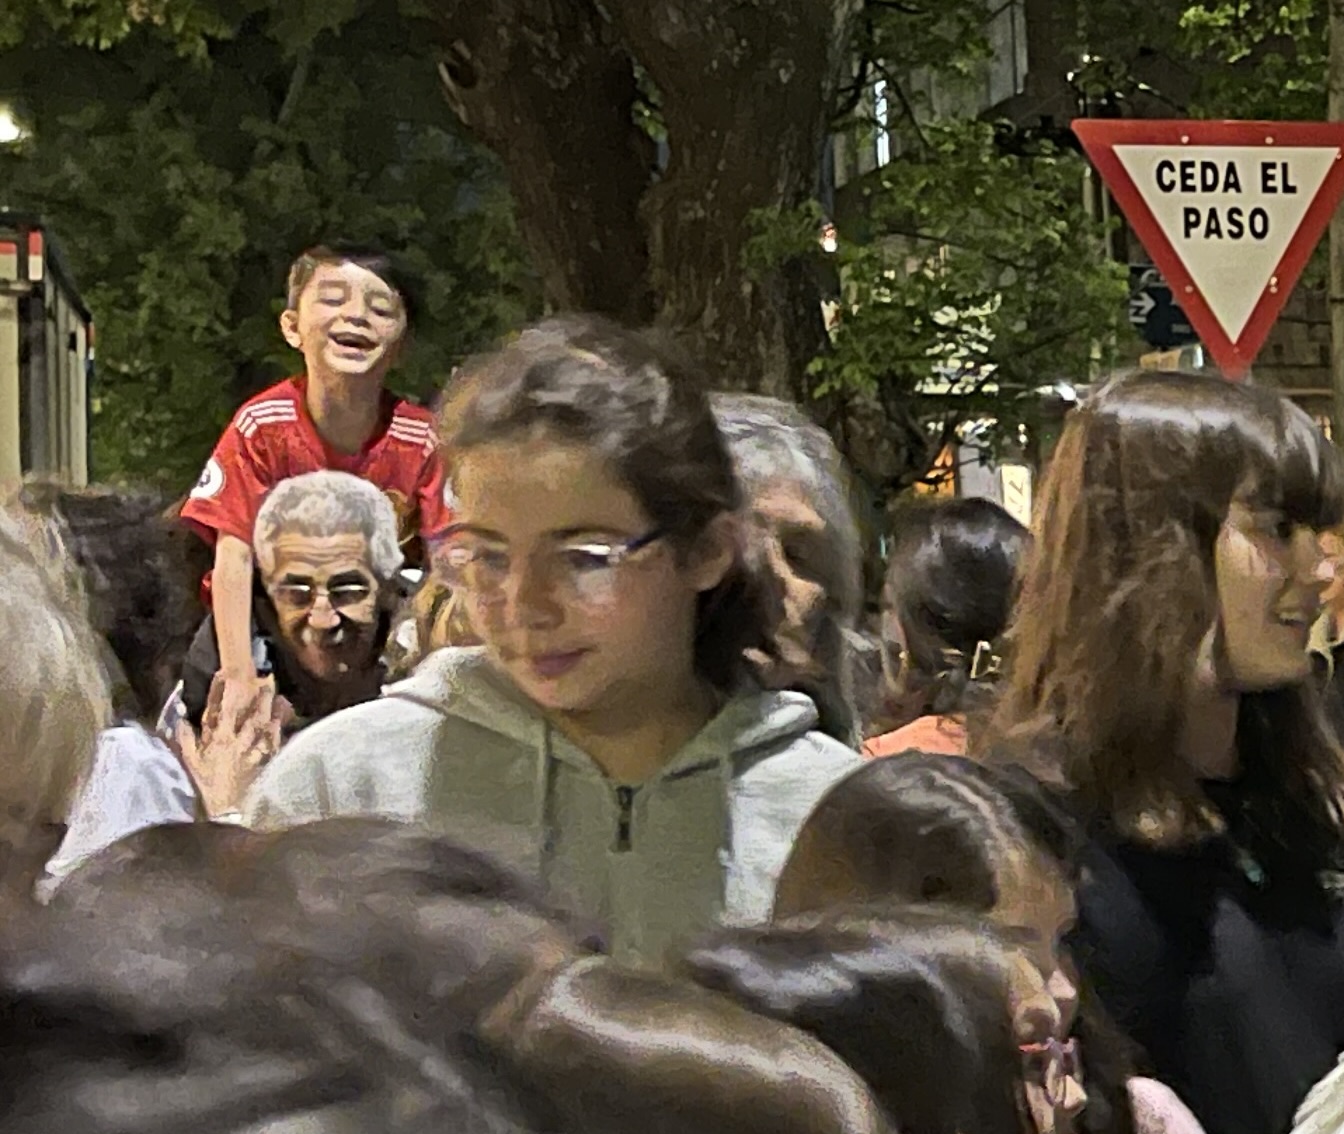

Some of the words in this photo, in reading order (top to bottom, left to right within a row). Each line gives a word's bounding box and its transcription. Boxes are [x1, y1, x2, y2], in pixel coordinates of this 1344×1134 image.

[1155, 159, 1242, 193] CEDA
[1260, 161, 1298, 194] EL
[1183, 206, 1270, 240] PASO
